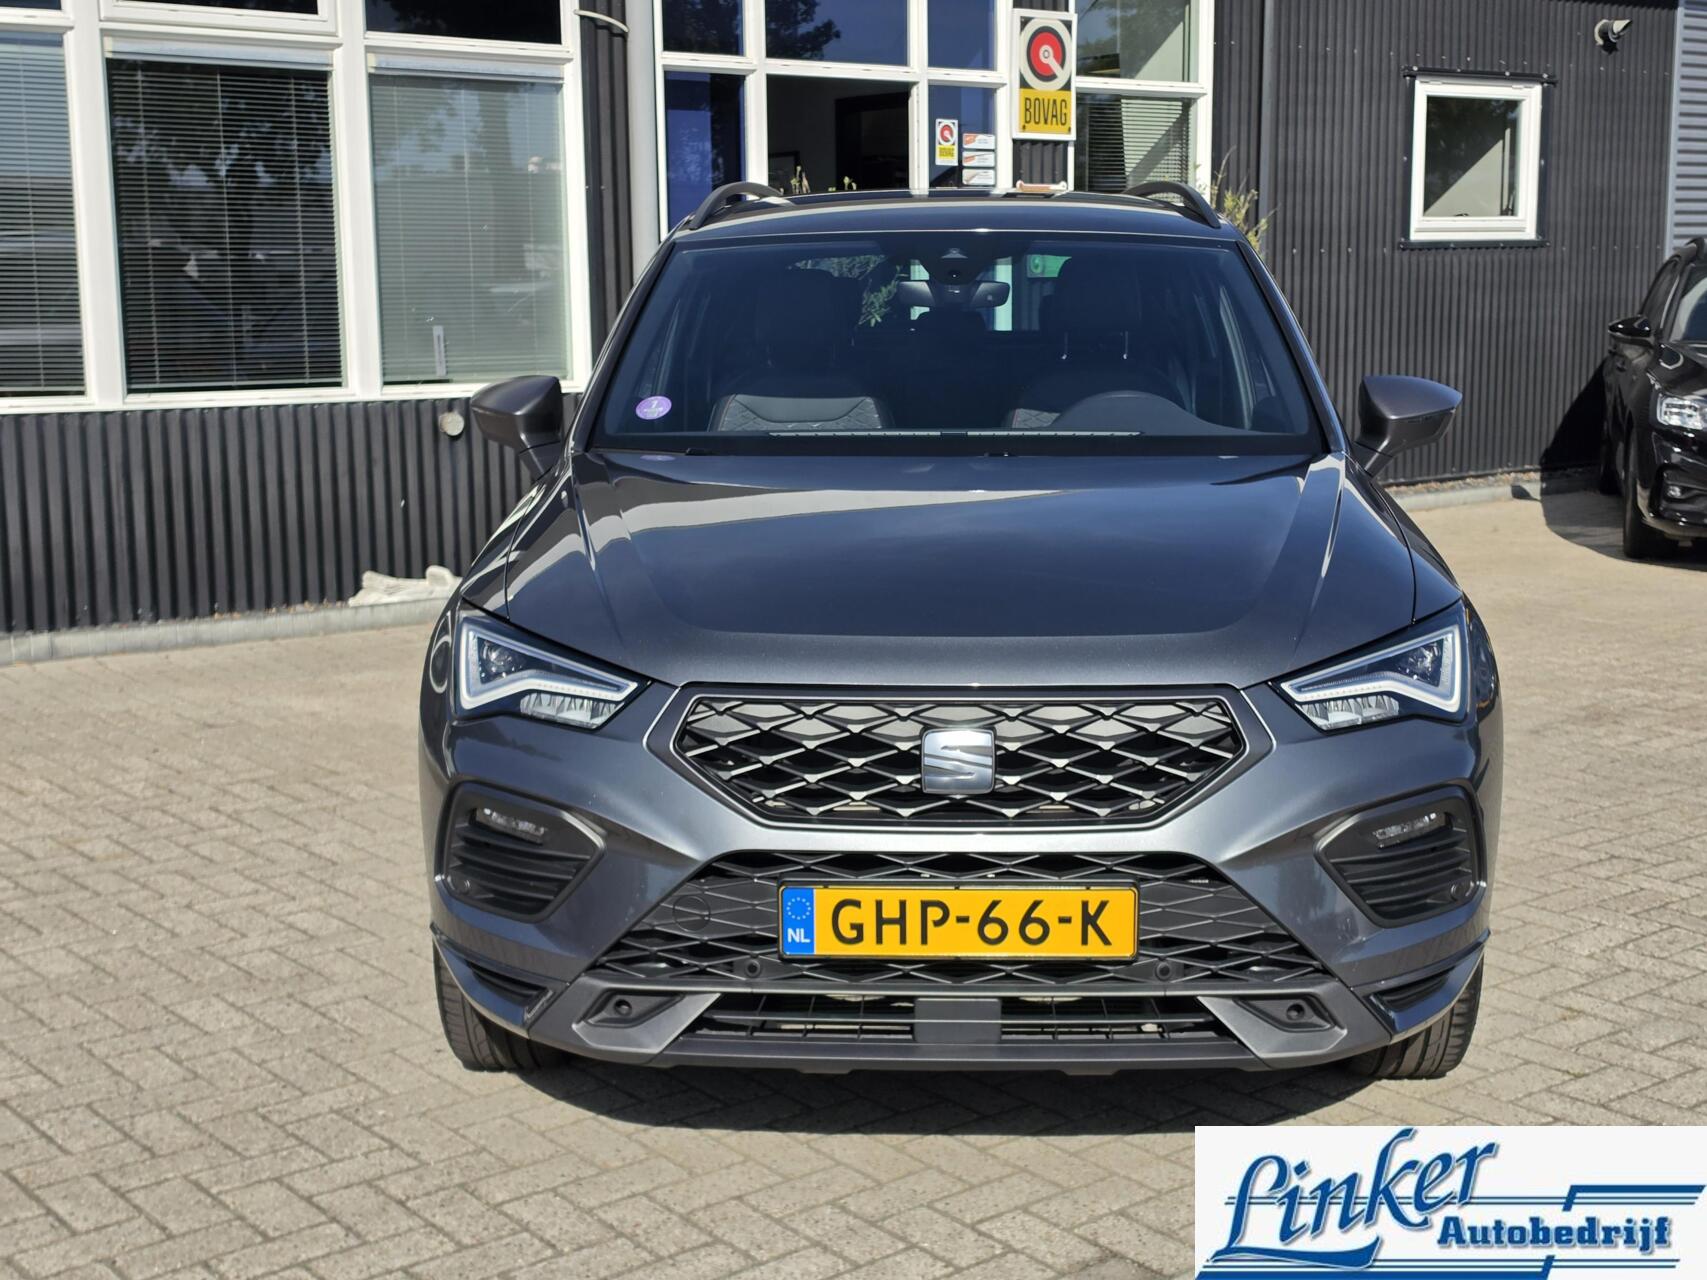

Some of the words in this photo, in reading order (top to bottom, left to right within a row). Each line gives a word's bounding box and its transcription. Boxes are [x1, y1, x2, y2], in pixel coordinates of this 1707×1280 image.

[1024, 97, 1067, 126] BOVAG
[787, 928, 810, 943] NL
[831, 898, 1112, 945] GHP-66-K
